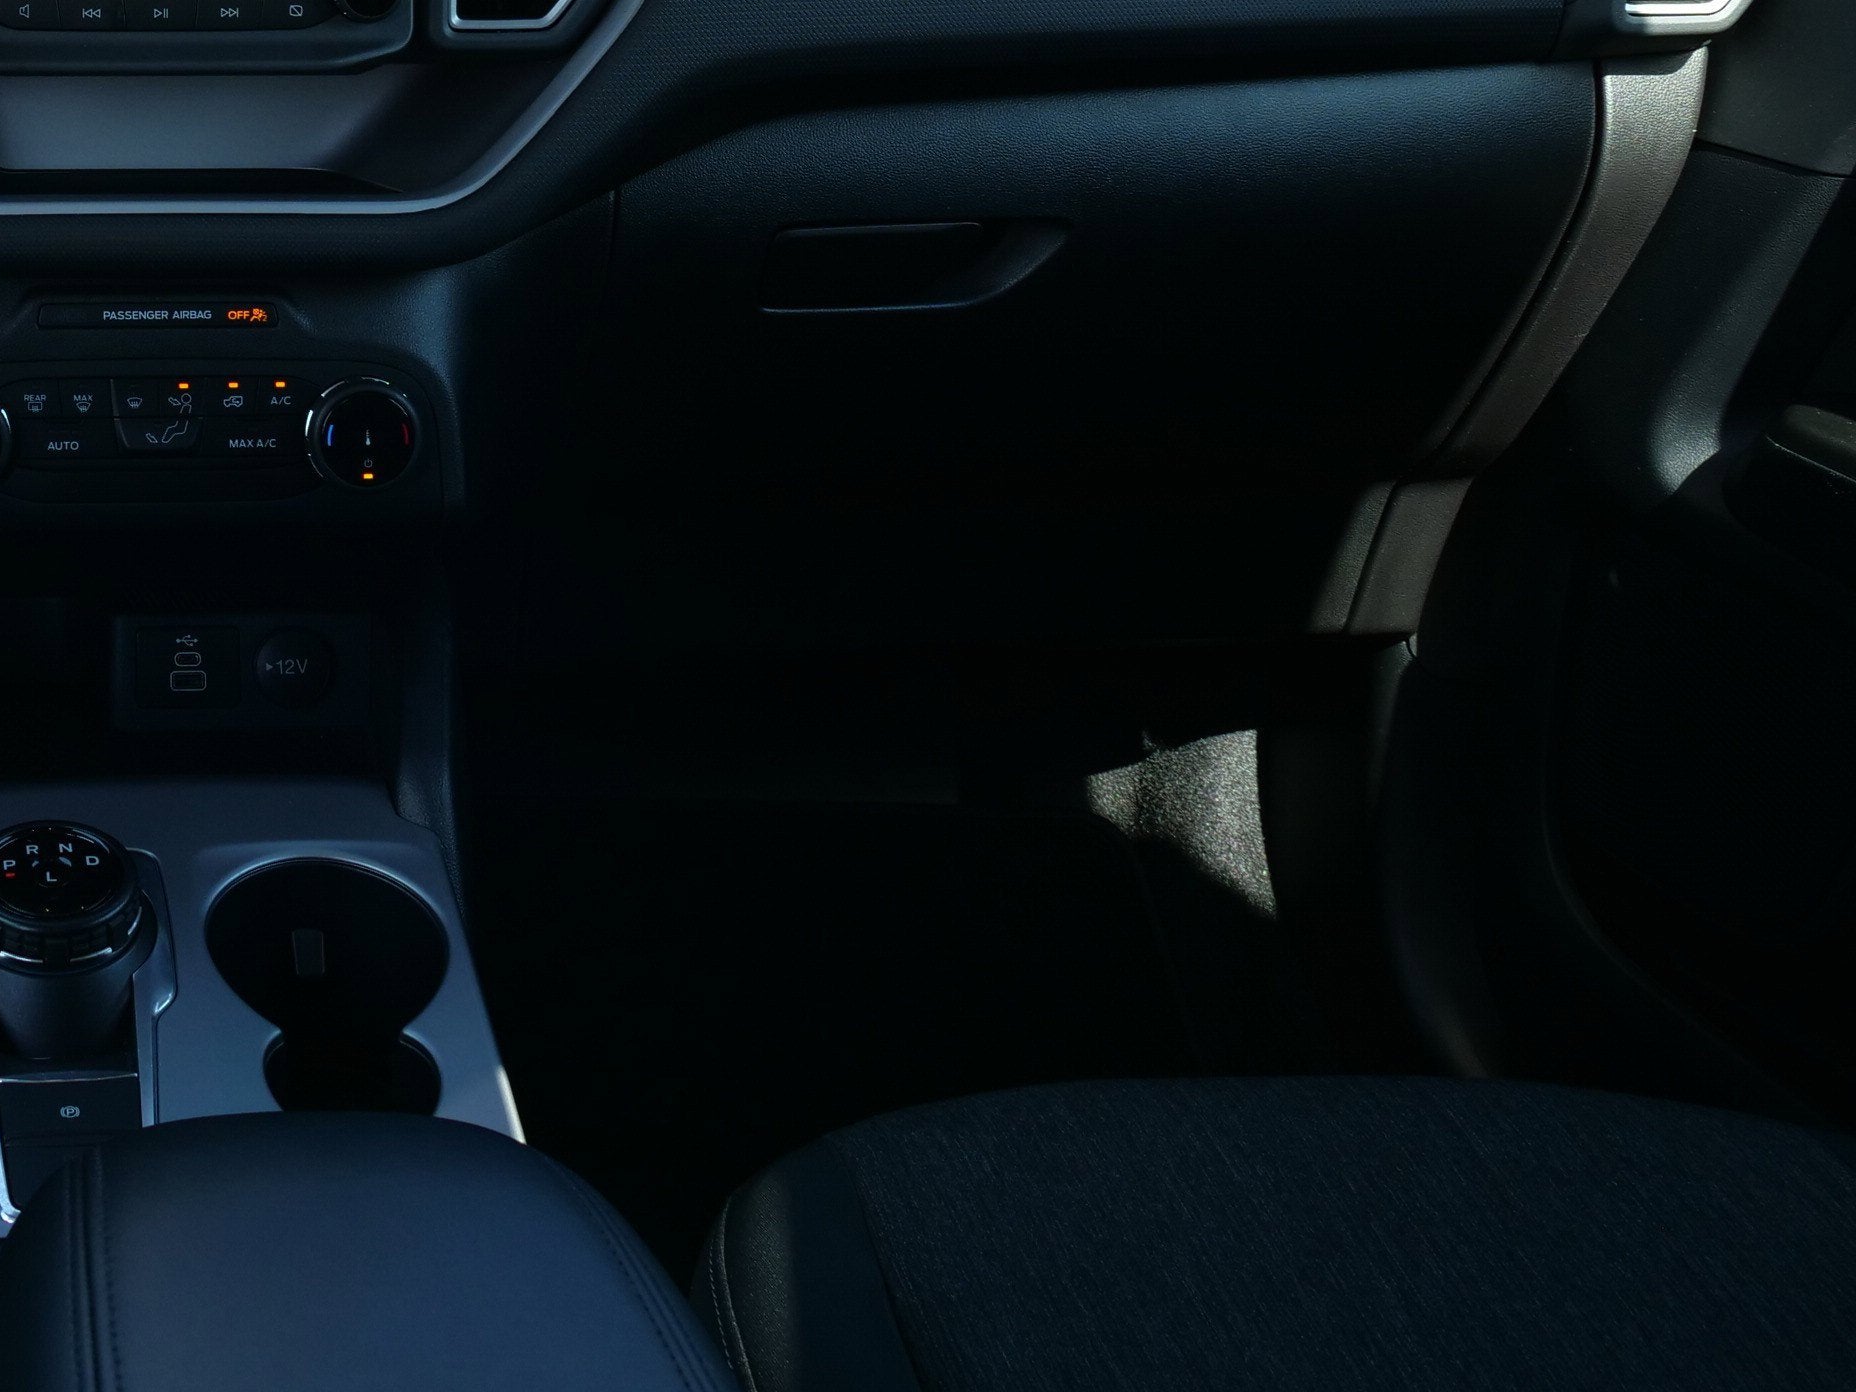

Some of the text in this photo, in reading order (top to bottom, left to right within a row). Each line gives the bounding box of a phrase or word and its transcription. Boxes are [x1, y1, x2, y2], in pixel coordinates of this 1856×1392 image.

[103, 310, 250, 320] PASSENGER AIRBAG OFF
[23, 394, 46, 402] REAR
[73, 394, 93, 402] MAX
[270, 396, 291, 405] A/C
[47, 441, 79, 451] AUTO
[229, 438, 277, 449] MAX A/C
[275, 659, 308, 675] 12V
[25, 844, 39, 855] R
[58, 842, 73, 853] N
[2, 859, 16, 871] P
[85, 855, 100, 866] D
[45, 871, 58, 882] L
